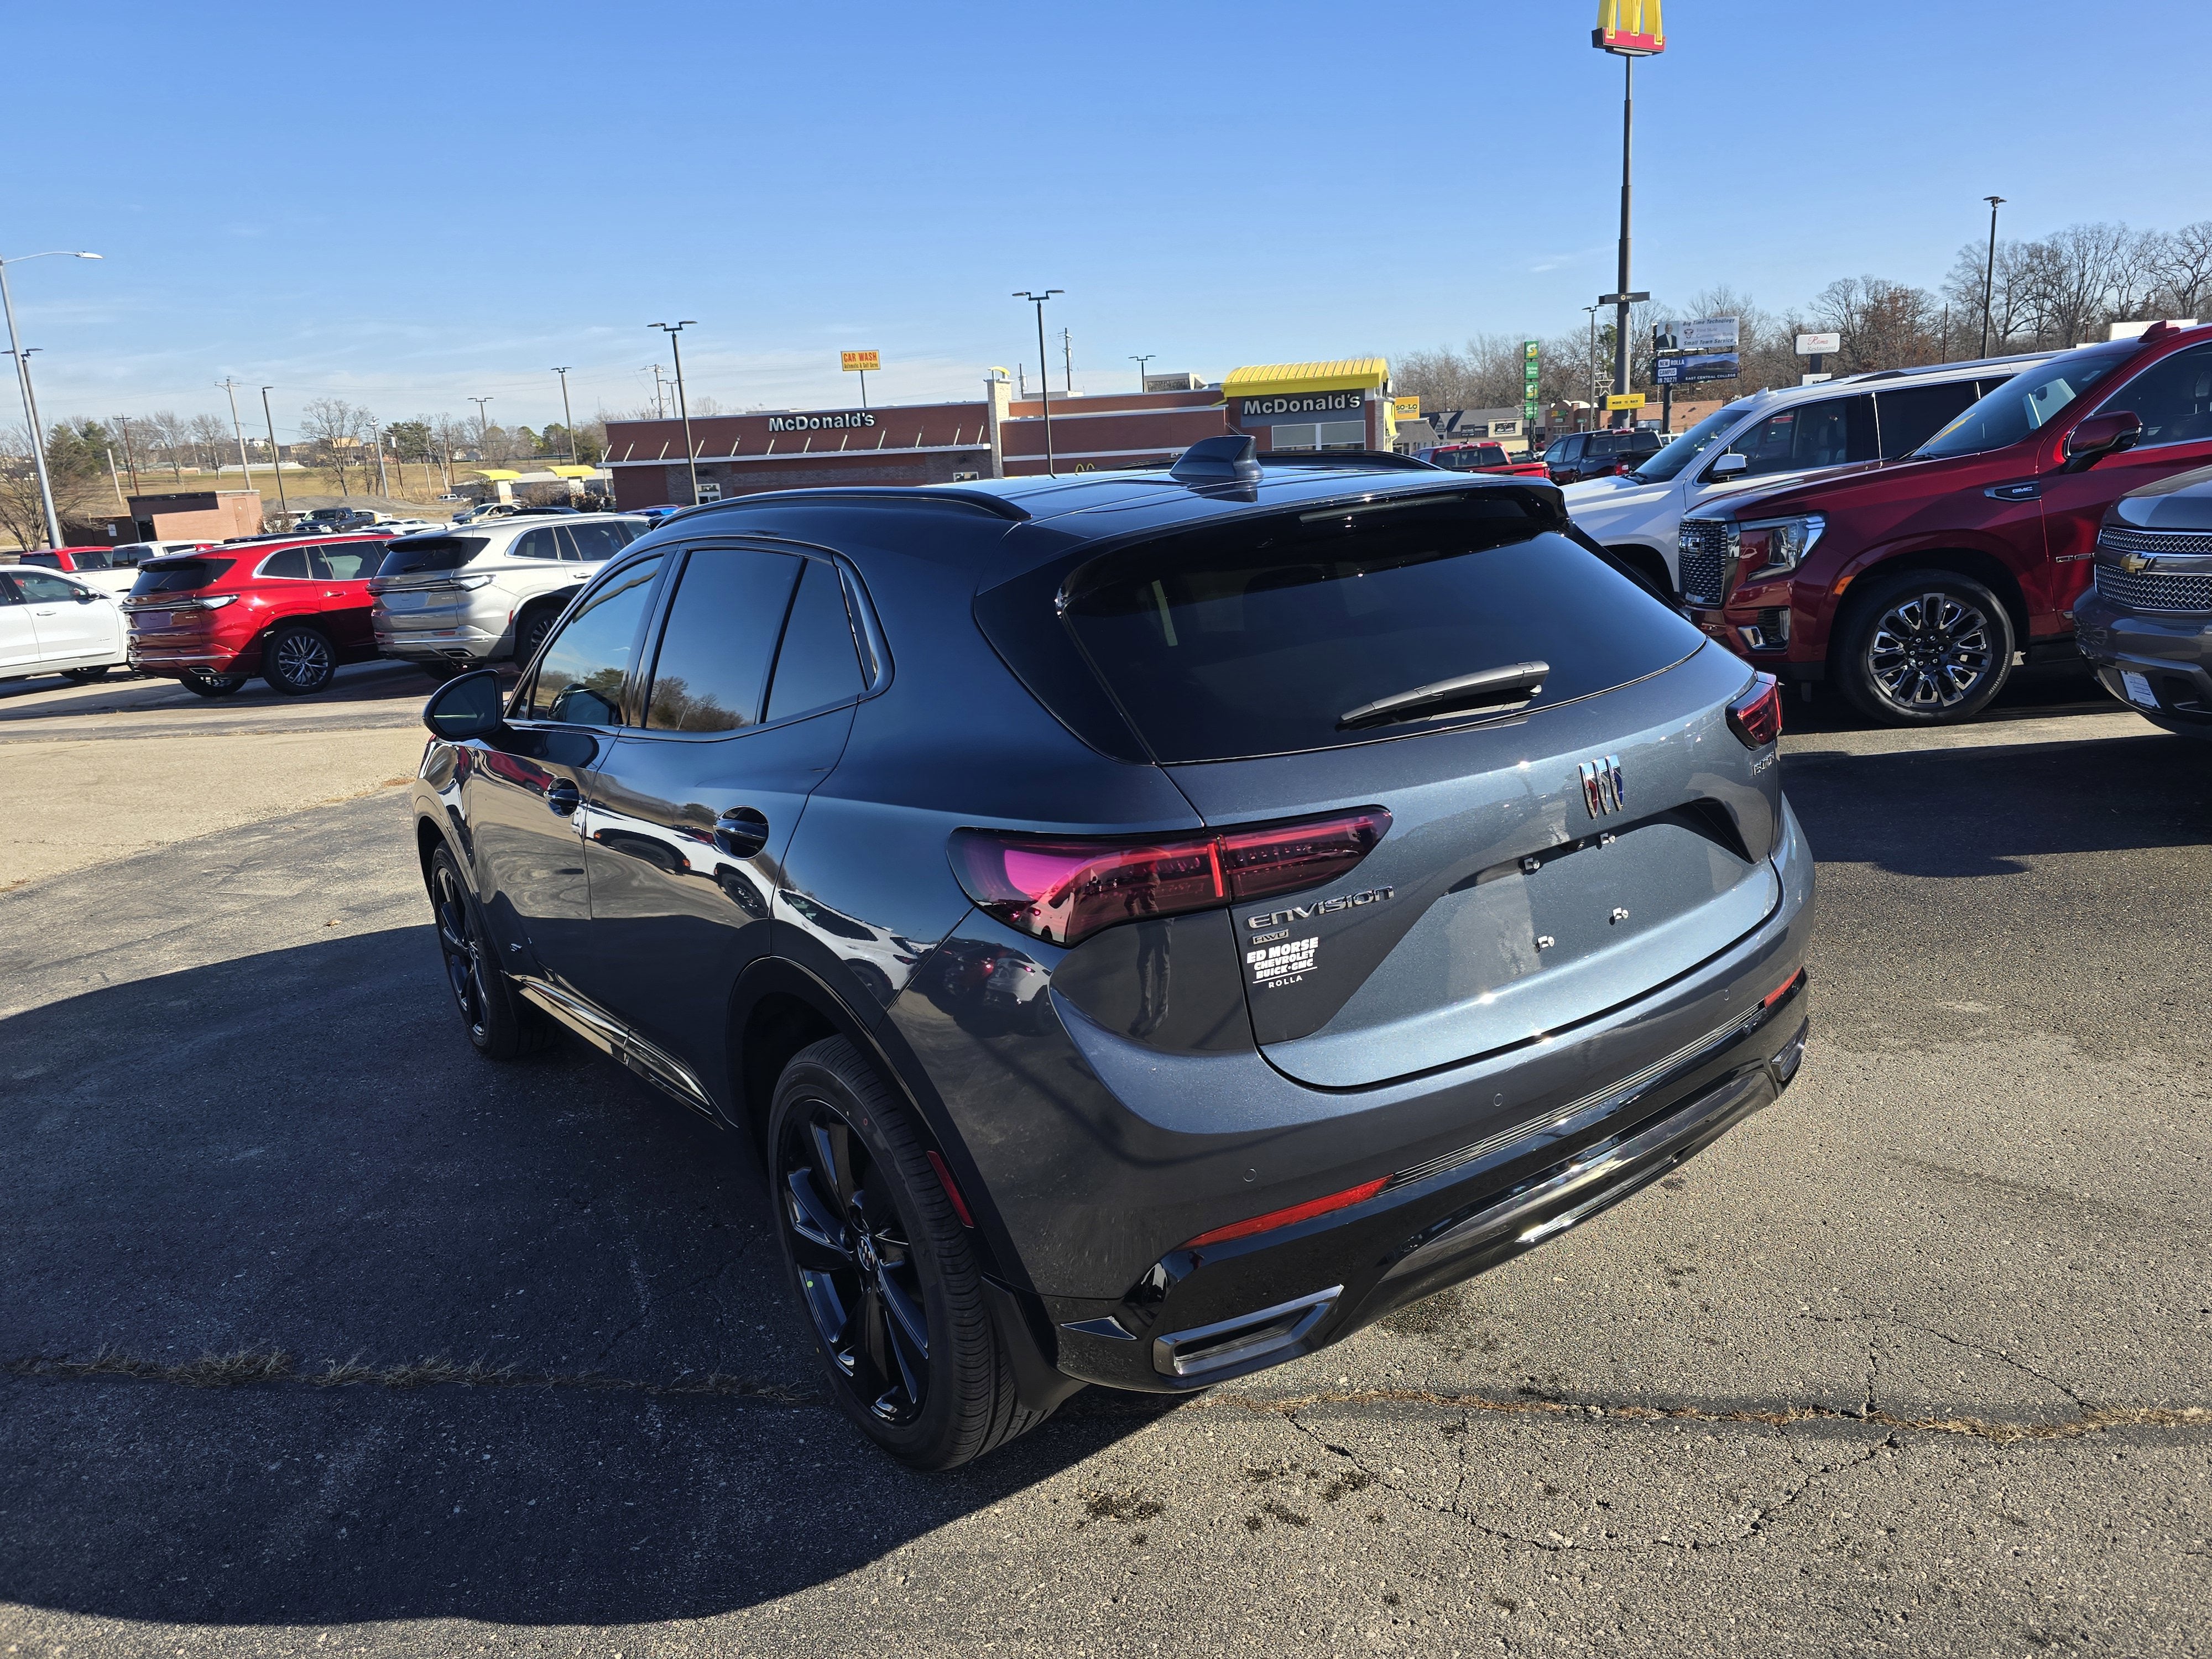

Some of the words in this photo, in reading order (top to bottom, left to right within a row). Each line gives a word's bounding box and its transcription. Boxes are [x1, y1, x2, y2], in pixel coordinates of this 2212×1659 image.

[843, 353, 856, 362] CAR
[858, 352, 877, 361] WASH
[1244, 394, 1360, 415] McDonald's
[769, 413, 875, 432] McDonald's
[1248, 885, 1395, 929] ENVISION
[1254, 931, 1287, 943] AWD
[1246, 950, 1266, 964] ED
[1269, 937, 1318, 958] MORSE
[1254, 948, 1315, 971] CHEVROLET
[1268, 975, 1303, 988] ROLLA
